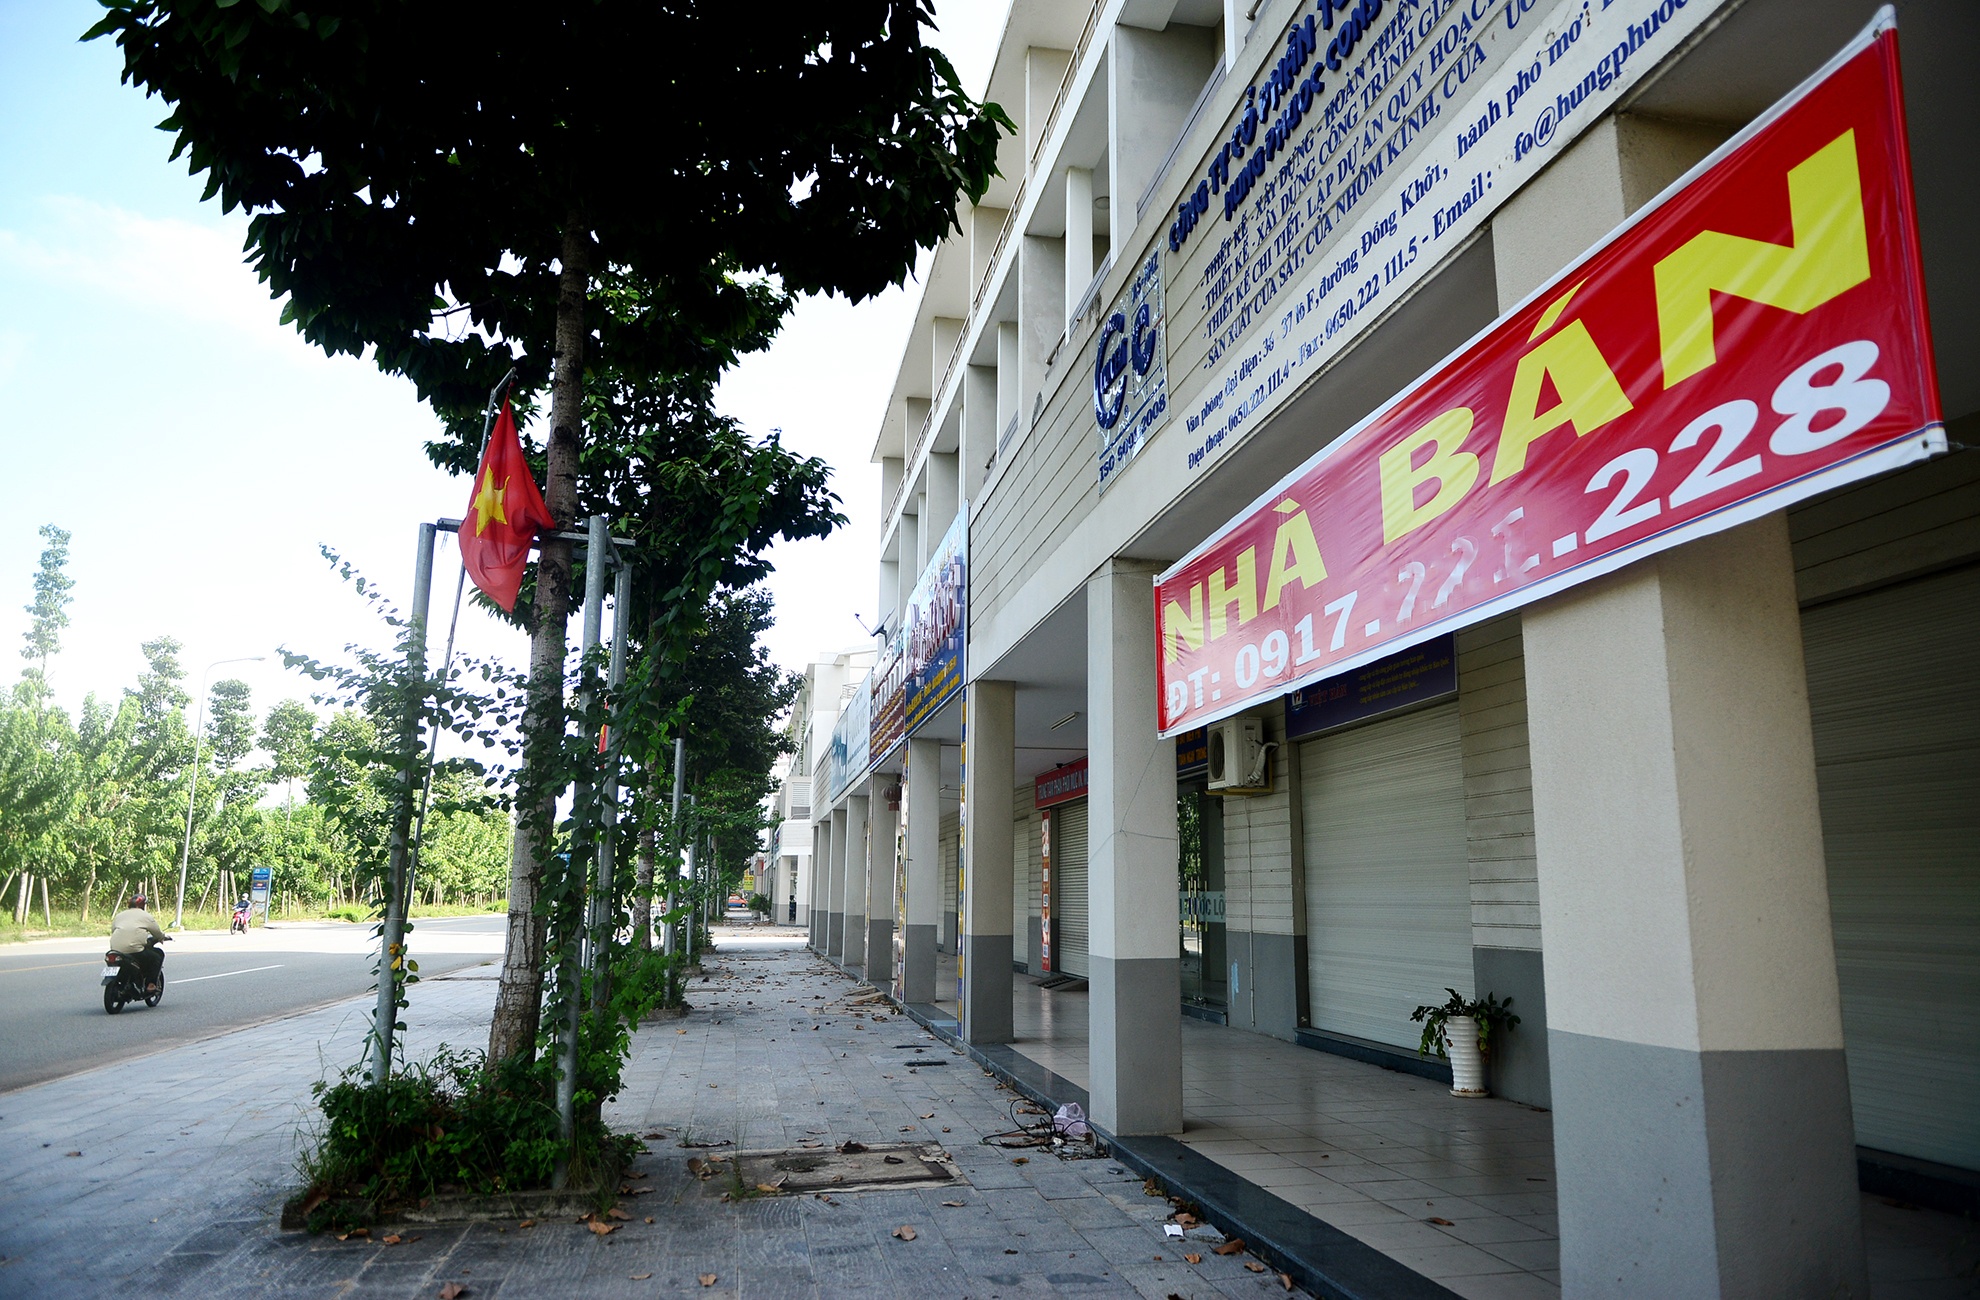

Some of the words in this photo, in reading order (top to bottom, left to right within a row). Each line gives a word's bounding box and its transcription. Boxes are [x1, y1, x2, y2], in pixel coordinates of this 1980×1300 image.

[1205, 263, 1232, 312] THIẾT
[1235, 235, 1249, 275] KẾ
[1280, 156, 1316, 217] DỰNG
[1319, 101, 1358, 165] CÔNG
[1361, 27, 1414, 113] TRÌNH
[1208, 142, 1230, 195] TY
[1254, 277, 1278, 314] CỬA
[1305, 213, 1333, 255] CỬA
[1336, 151, 1384, 224] NHÔM
[1386, 92, 1441, 166] KÍNH,
[1443, 41, 1487, 99] CỬA
[1324, 58, 1366, 130] HOÀN
[1206, 292, 1234, 338] THIẾT
[1236, 265, 1251, 305] KẾ
[1252, 246, 1272, 283] CHI
[1307, 172, 1334, 220] LẬP
[1337, 136, 1359, 185] DỰ
[1362, 110, 1383, 157] ÁN
[1388, 60, 1424, 123] QUY
[1361, 210, 1398, 257] Đồng
[1164, 498, 1328, 667] NHÀ
[1379, 127, 1871, 546] BÁN
[1168, 666, 1221, 720] ĐT:
